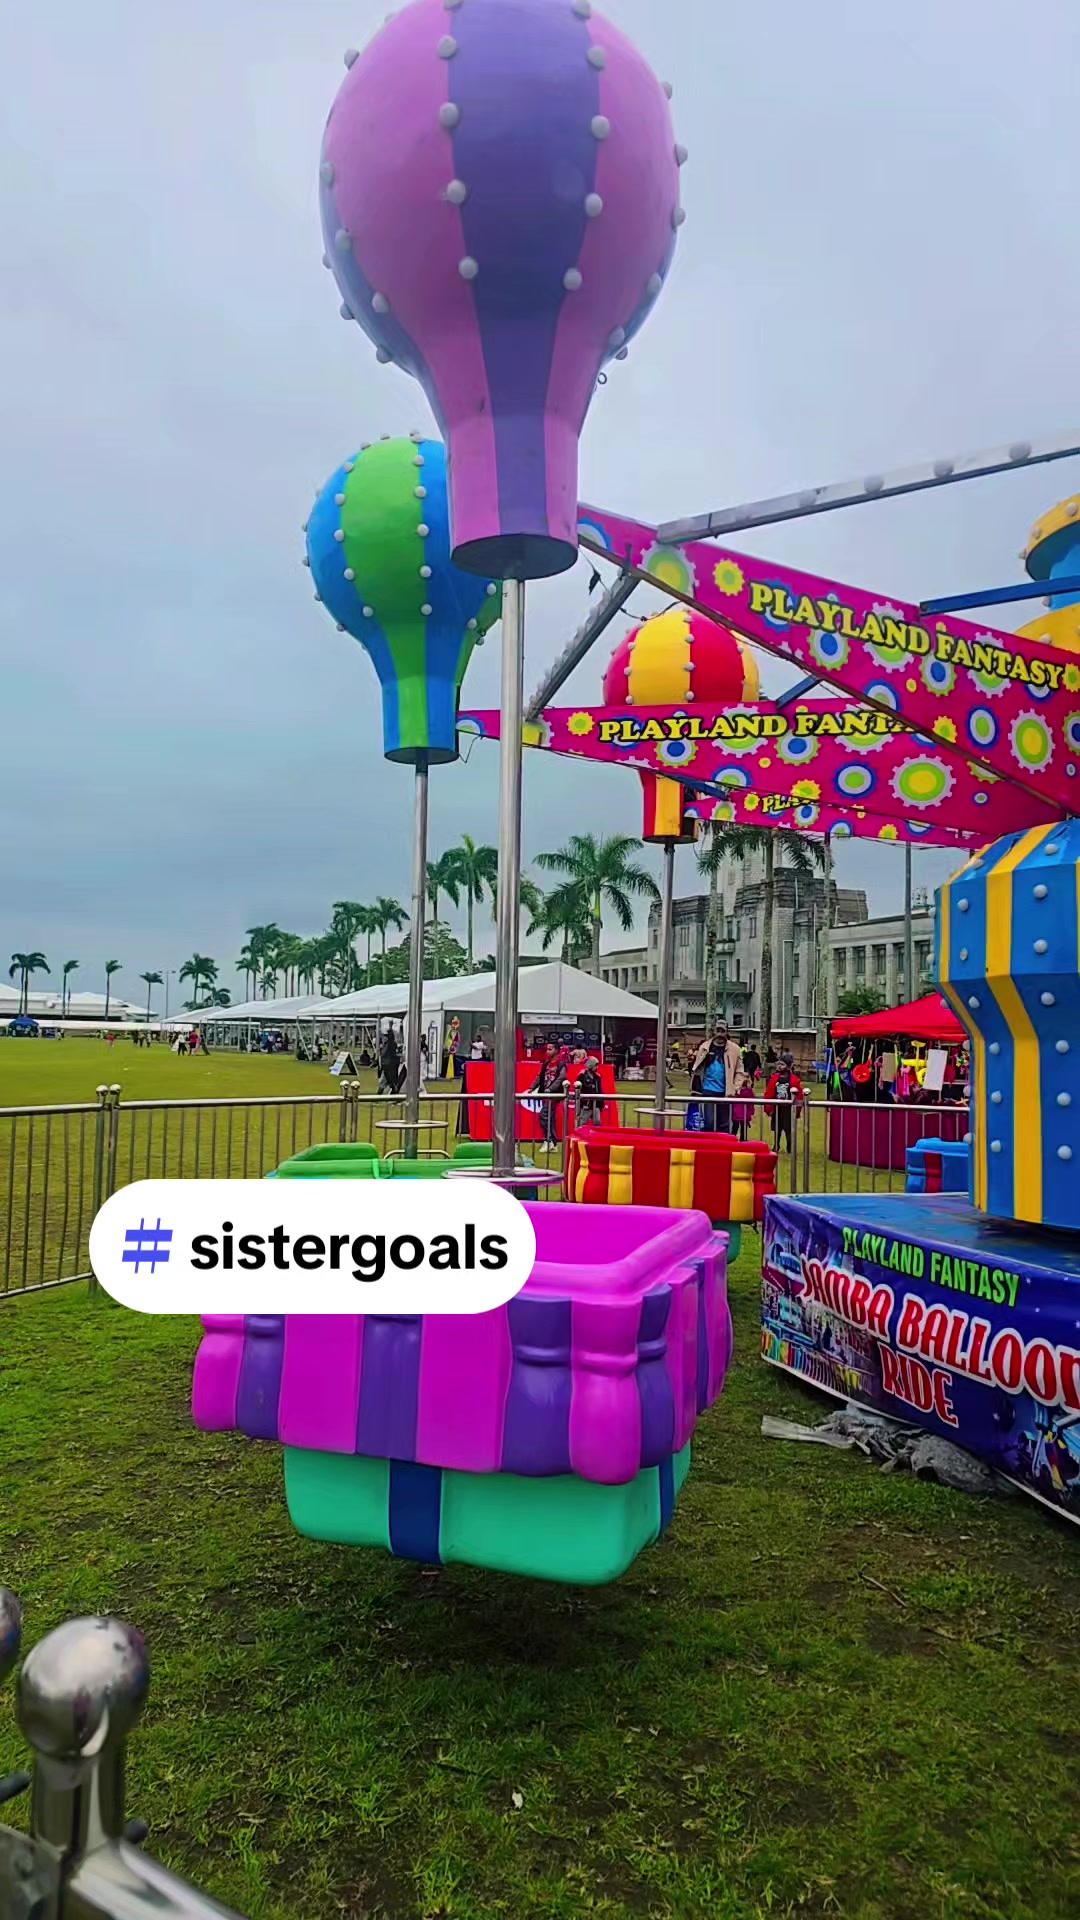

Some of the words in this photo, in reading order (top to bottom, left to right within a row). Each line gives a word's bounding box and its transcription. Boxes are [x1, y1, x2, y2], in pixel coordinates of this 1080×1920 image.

[748, 581, 932, 656] PLAYLAND
[934, 631, 1065, 690] FANTASY
[598, 714, 788, 743] PLAYLAND
[841, 1226, 925, 1278] PLAYLAND
[929, 1249, 1020, 1307] FANTASY
[876, 1341, 960, 1428] RIDE
